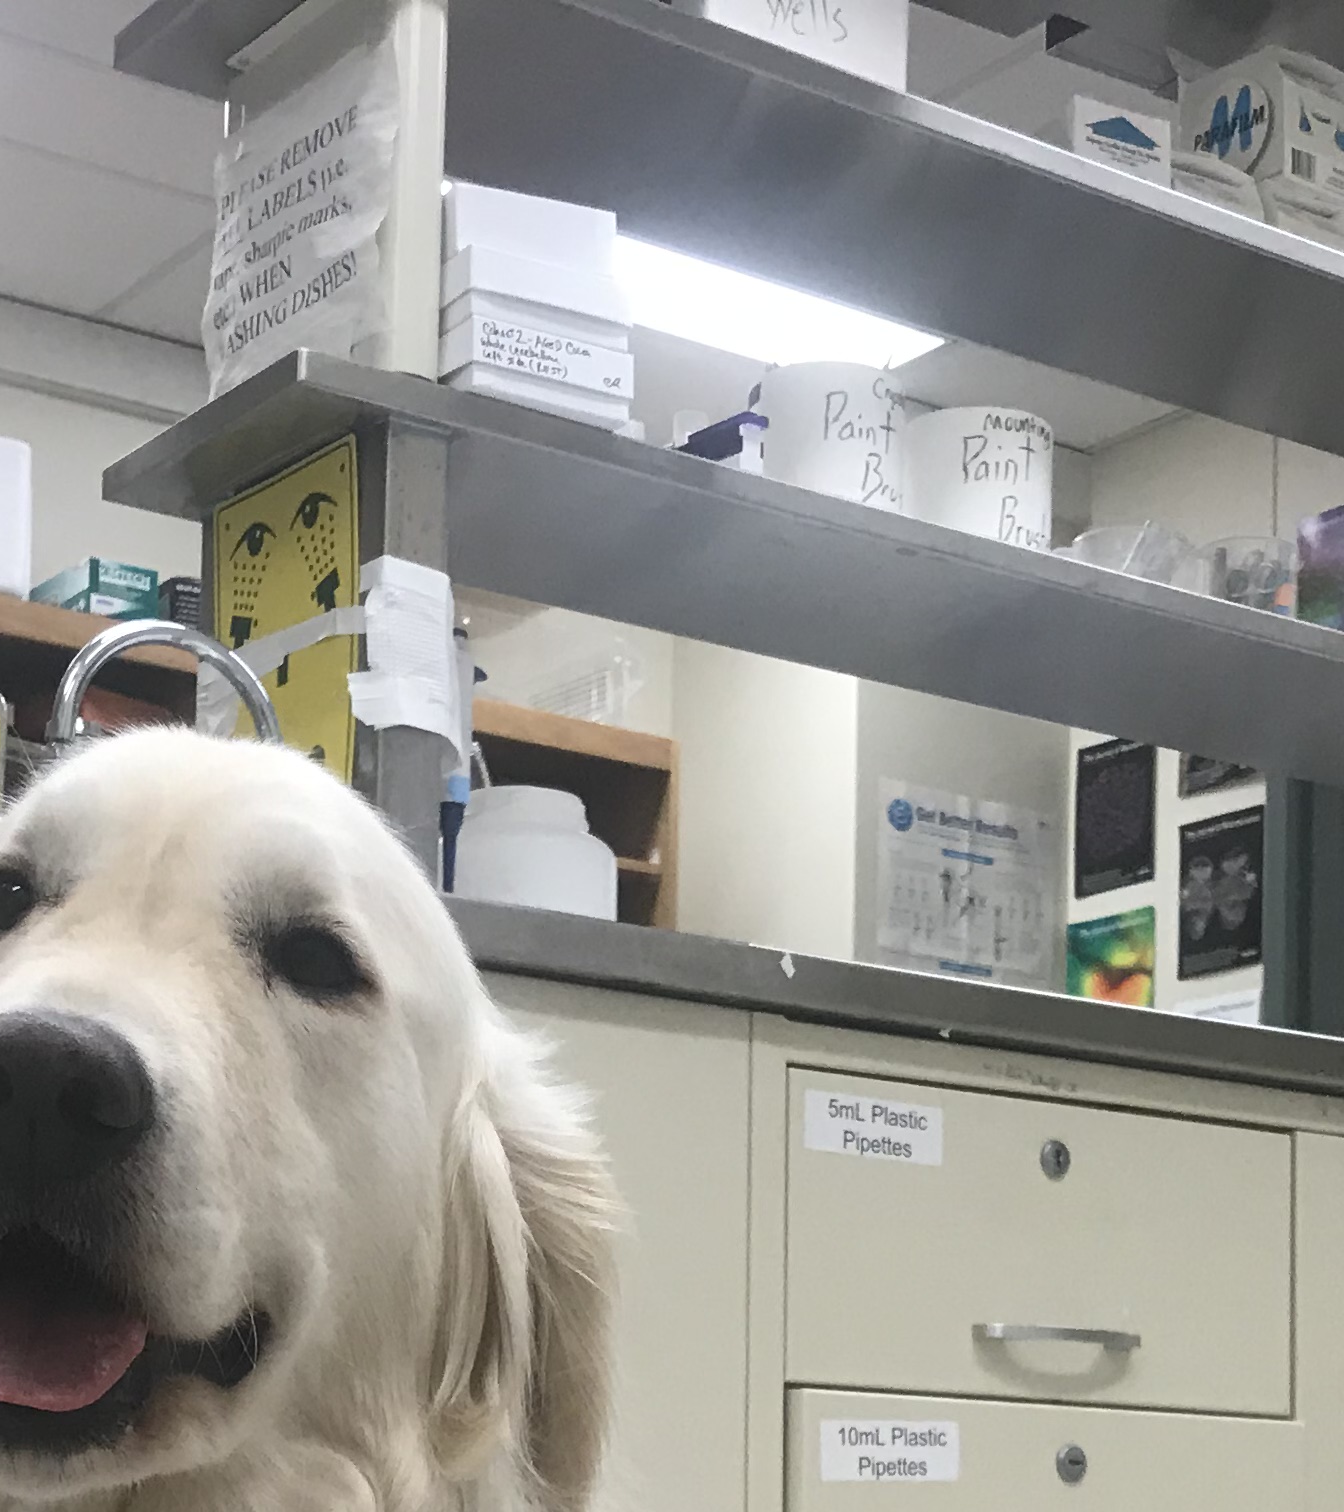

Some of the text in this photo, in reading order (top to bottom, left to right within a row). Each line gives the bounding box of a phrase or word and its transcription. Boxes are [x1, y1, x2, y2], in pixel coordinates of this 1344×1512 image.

[280, 104, 359, 175] REMOVE
[226, 249, 358, 354] ASHING DISHES!
[240, 253, 293, 307] WHEN
[823, 390, 896, 454] Paint
[962, 434, 1036, 484] Paint
[827, 1098, 928, 1131] 5mL Plastic
[843, 1129, 913, 1158] Pipettes
[838, 1426, 948, 1447] 10mL Plastic
[858, 1456, 928, 1481] Pipettes
